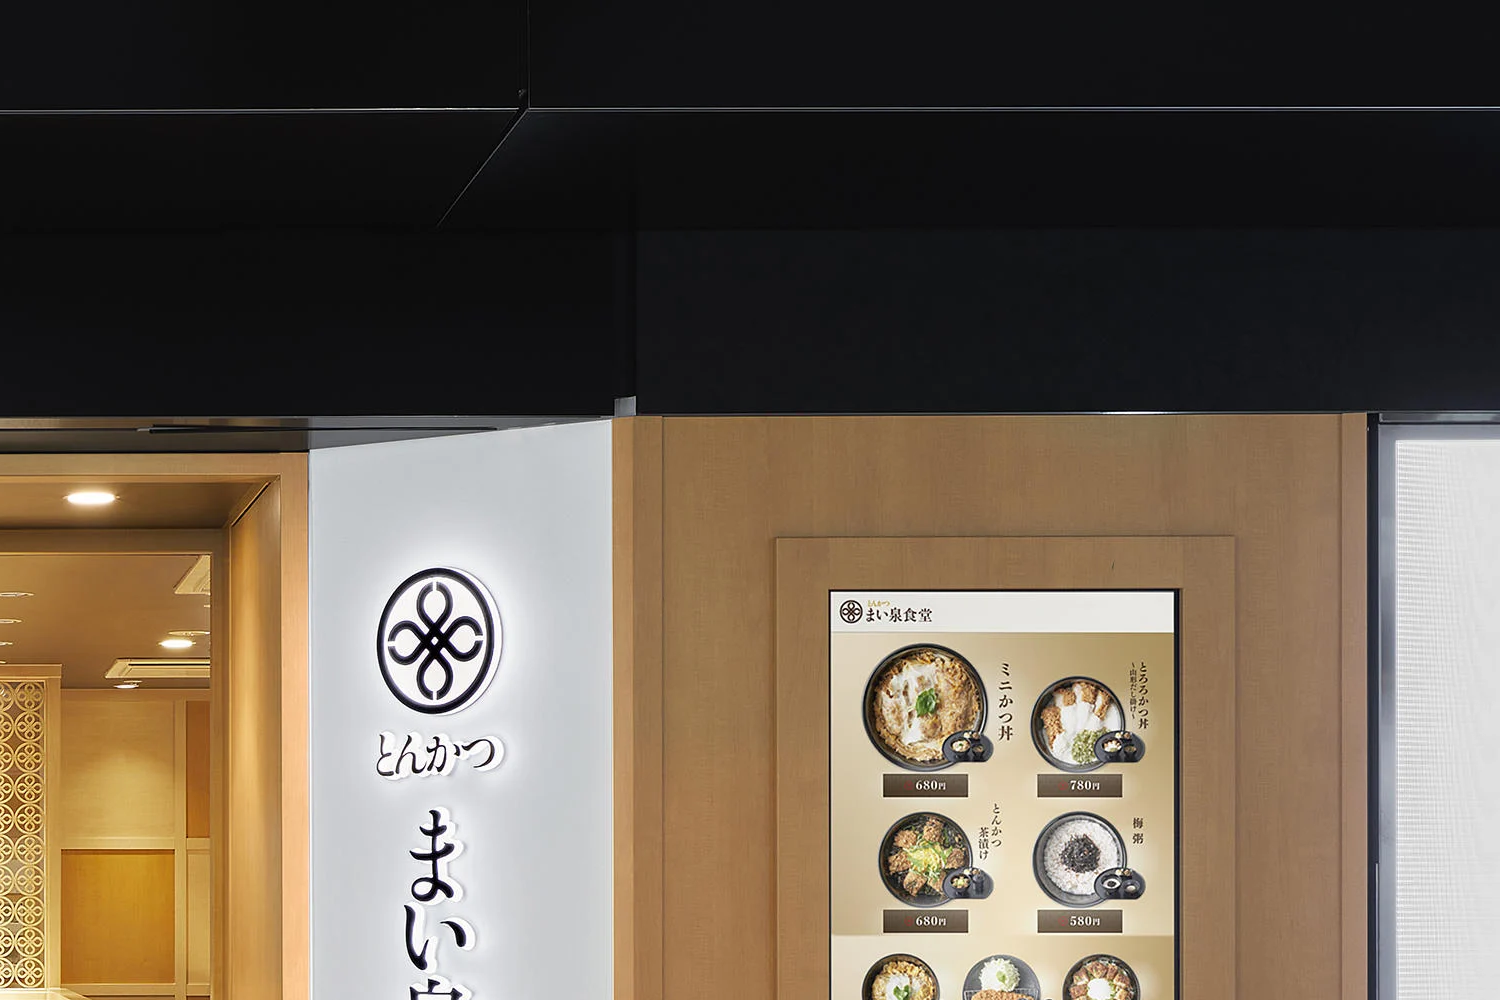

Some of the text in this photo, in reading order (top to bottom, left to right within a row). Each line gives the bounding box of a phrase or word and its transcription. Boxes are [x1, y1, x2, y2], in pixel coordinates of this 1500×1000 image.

[865, 607, 933, 623] まい泉食堂
[998, 662, 1014, 742] ミニかつ丼
[1138, 661, 1149, 730] とろろかつ丼
[375, 732, 497, 777] とんかつ
[914, 779, 947, 791] 680円
[1069, 779, 1101, 791] 780円
[990, 802, 1003, 848] とんかつ
[977, 826, 990, 860] 茶漬け
[914, 915, 947, 927] 680円
[1069, 915, 1101, 927] 580円
